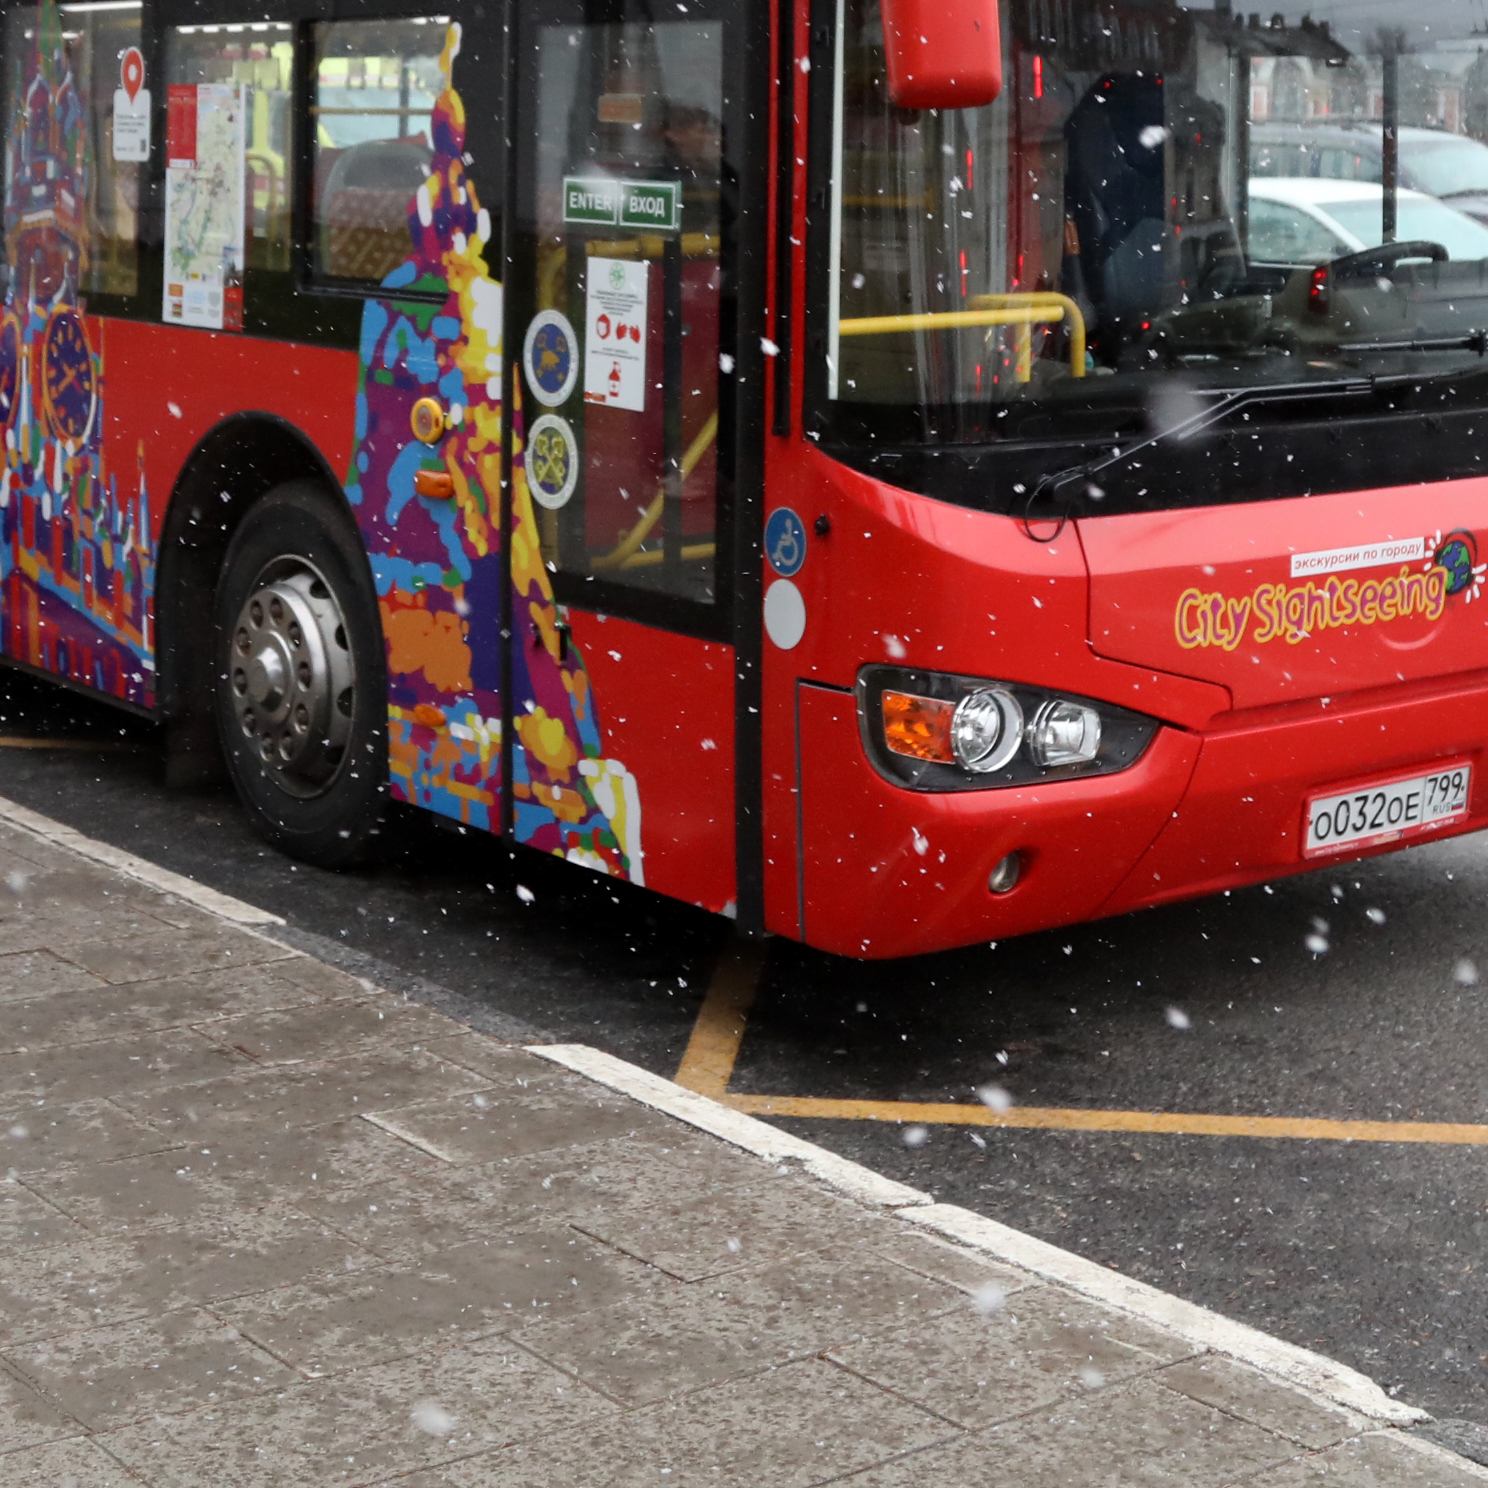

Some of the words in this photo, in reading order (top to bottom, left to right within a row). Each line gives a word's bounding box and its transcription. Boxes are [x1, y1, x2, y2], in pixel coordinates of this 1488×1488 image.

[569, 191, 612, 212] ENTER
[629, 195, 665, 218] ВХОД
[1294, 549, 1361, 571] экскурсии
[1363, 549, 1378, 560] по
[1381, 542, 1422, 561] городу
[1427, 771, 1464, 806] 799
[1432, 802, 1452, 815] RUS
